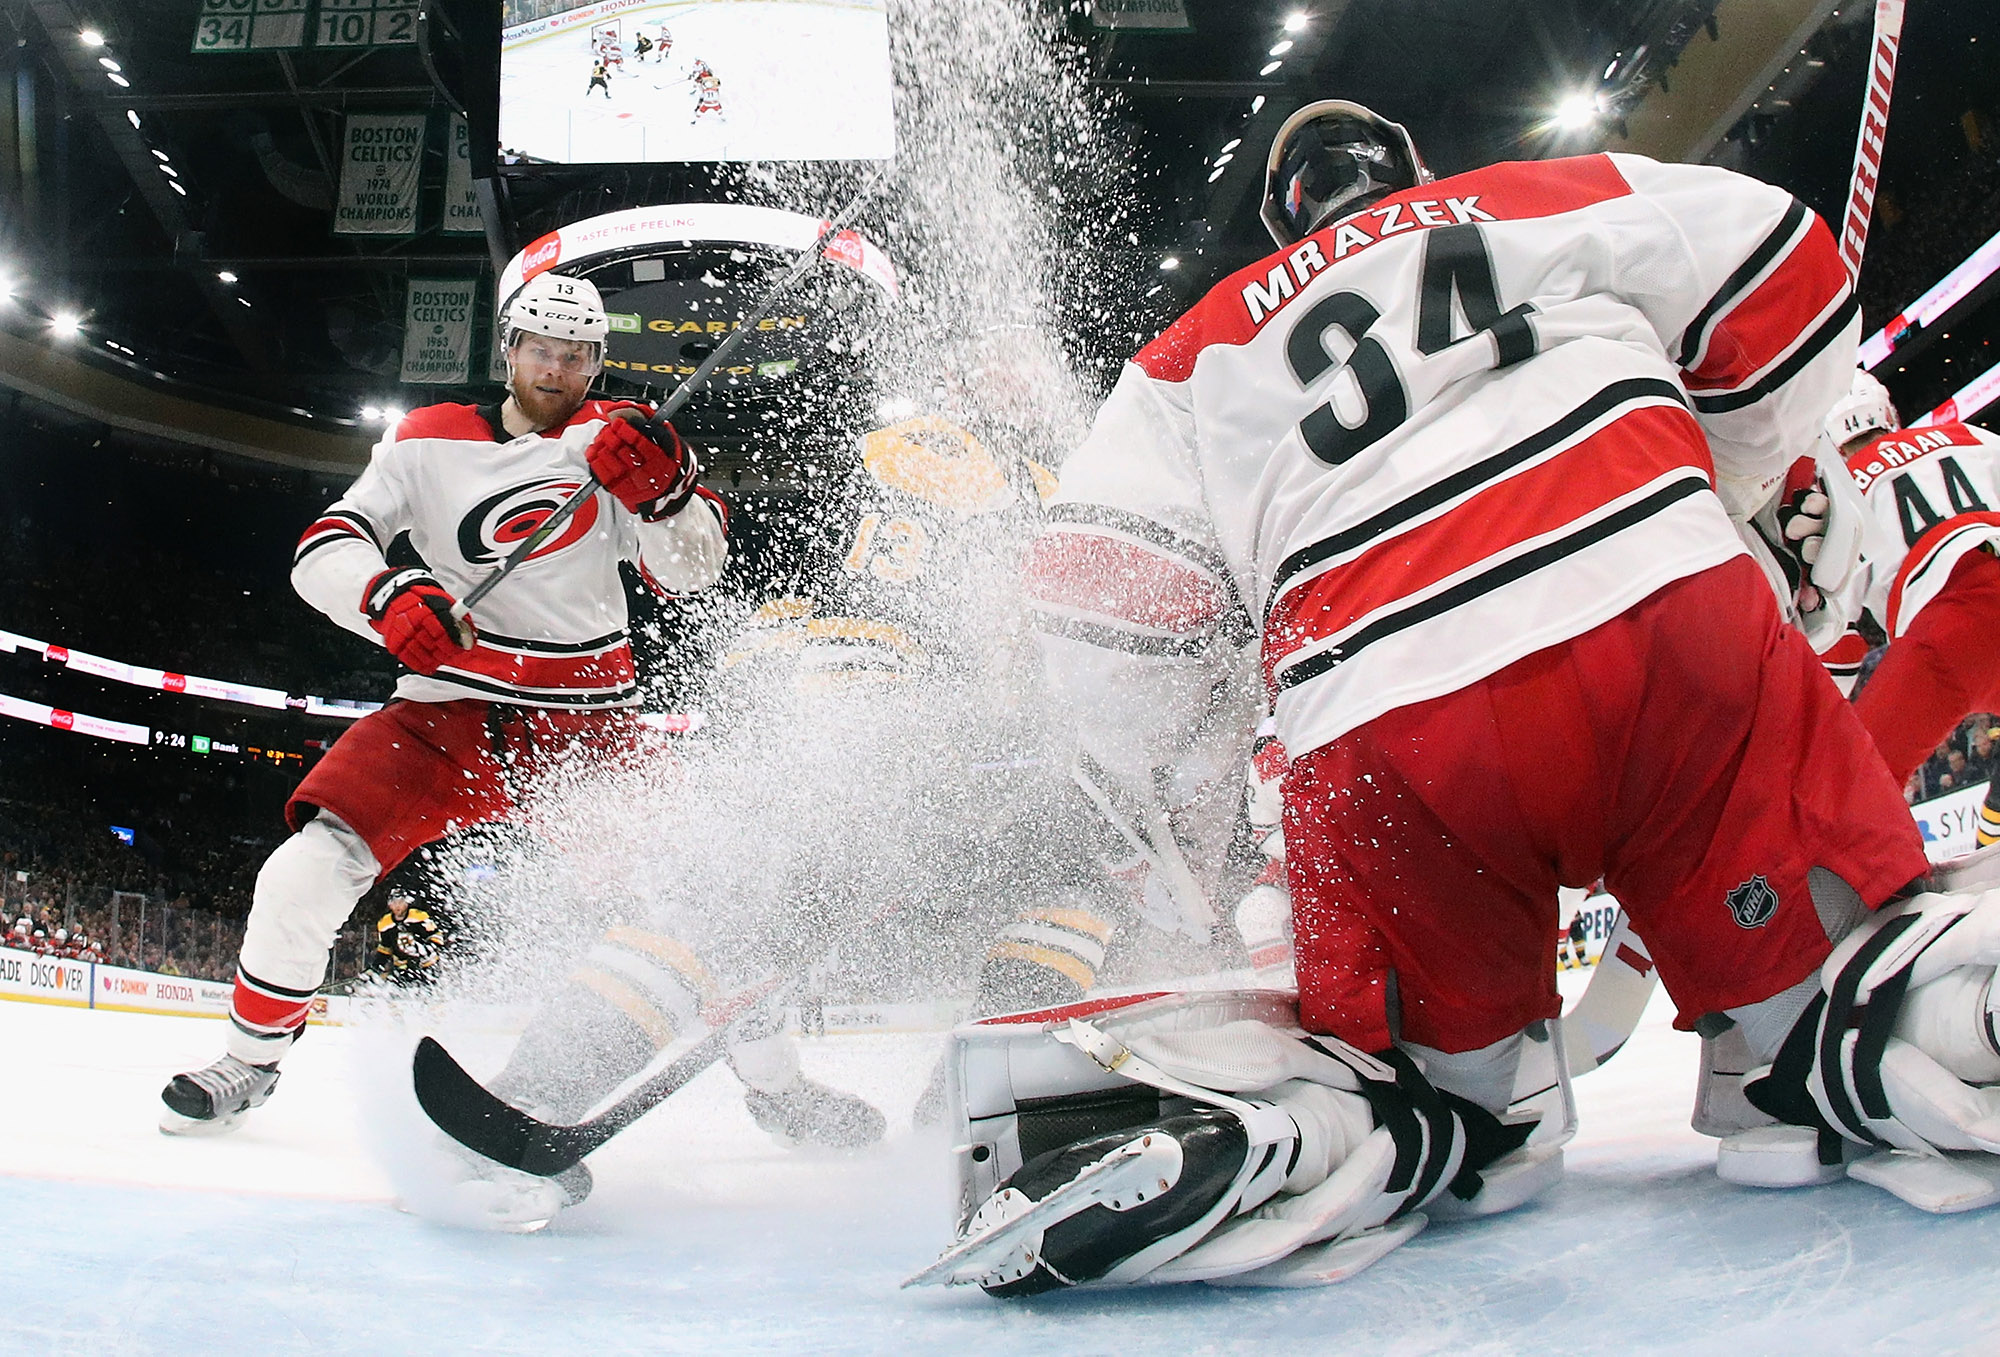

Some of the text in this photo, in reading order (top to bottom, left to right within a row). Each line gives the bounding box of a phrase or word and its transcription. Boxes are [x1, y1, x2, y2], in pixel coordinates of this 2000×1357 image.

[600, 0, 646, 13] HONDA
[201, 18, 244, 46] 34
[323, 12, 413, 43] 10 2
[351, 126, 418, 144] BOSTON
[351, 144, 413, 163] CELTICS
[1845, 34, 1899, 272] ARRIO
[366, 178, 391, 191] 1974
[355, 193, 399, 206] WORLD
[339, 206, 411, 220] CHAMPIONS
[522, 217, 696, 273] Coca-Cola TASTE THE FEELING
[557, 283, 575, 295] 13
[412, 291, 470, 306] BOSTON
[413, 308, 466, 322] CELTICS
[544, 311, 579, 322] CCM
[419, 349, 455, 360] WORLD
[1282, 221, 1544, 470] 34
[405, 360, 466, 373] CHAMPIONS
[1891, 455, 1991, 551] 44
[154, 730, 186, 748] 9:24
[194, 738, 208, 751] TD
[211, 740, 240, 754] Bank
[1742, 888, 1764, 922] NHL
[30, 962, 83, 992] DISCOVER
[156, 983, 194, 1002] HONDA
